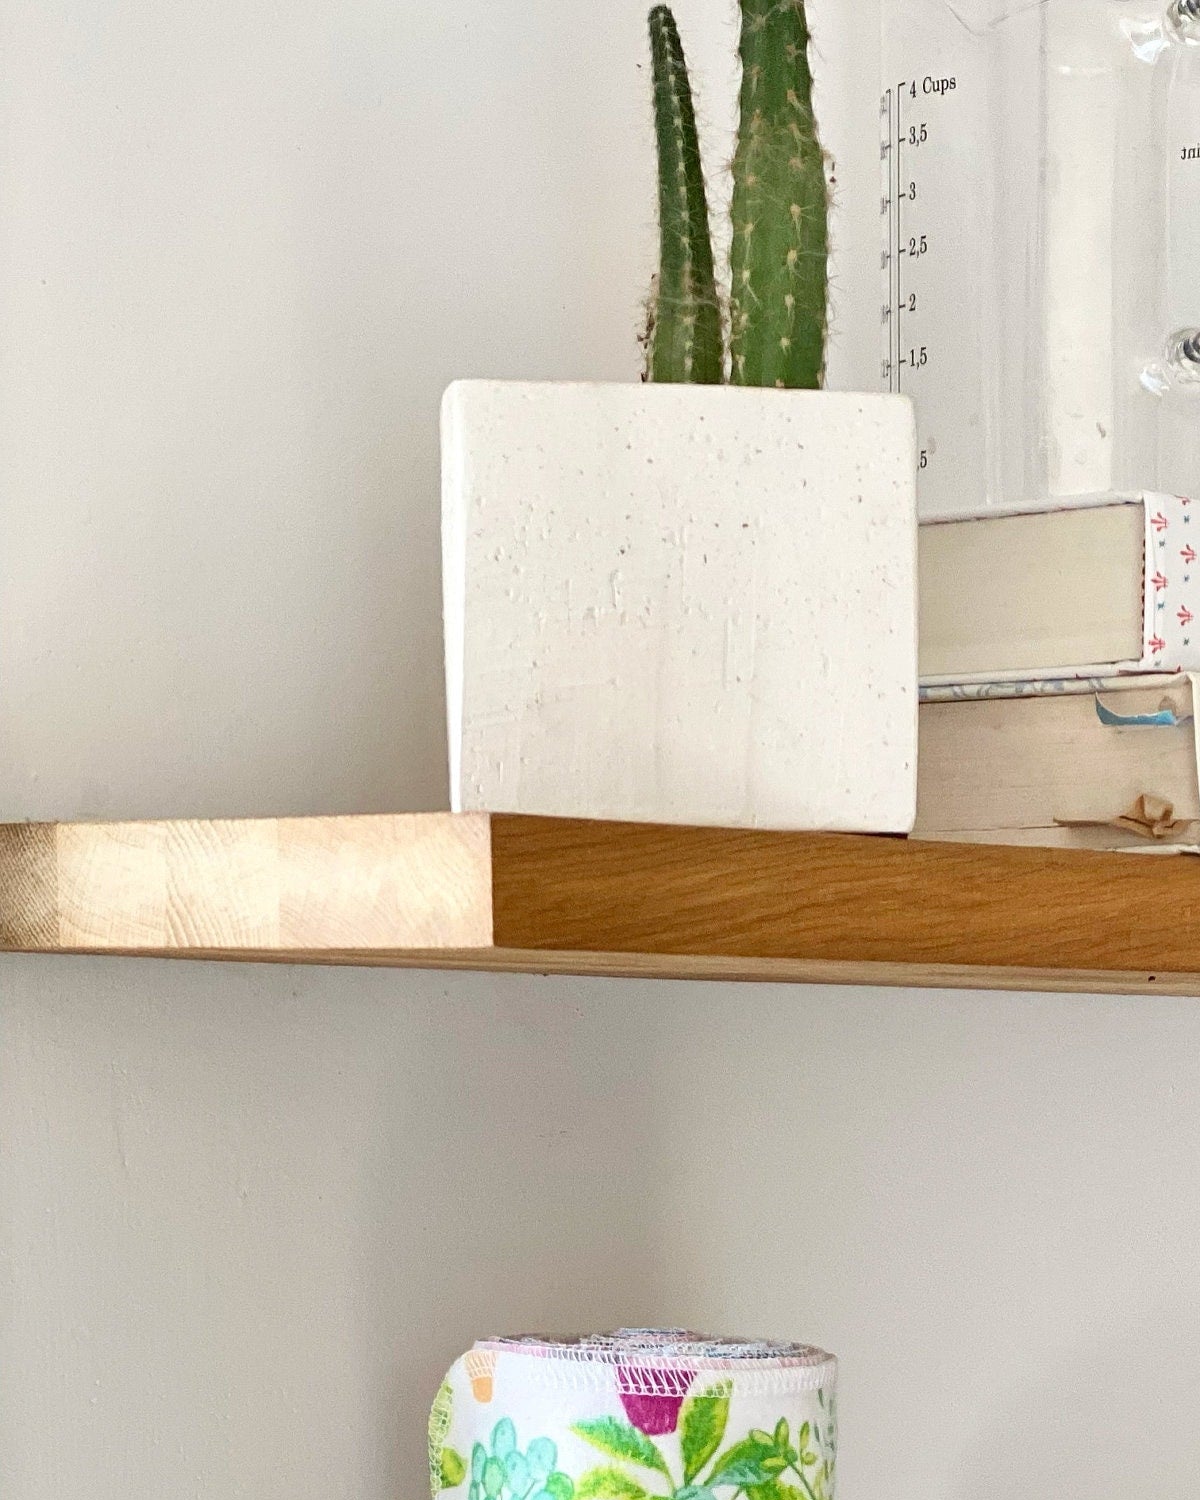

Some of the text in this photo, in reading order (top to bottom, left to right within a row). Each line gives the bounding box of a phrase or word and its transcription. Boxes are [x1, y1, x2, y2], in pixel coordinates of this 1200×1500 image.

[909, 76, 957, 98] 4 Cups
[909, 122, 928, 147] 3,5
[909, 181, 916, 200] 3
[909, 235, 928, 259] 2,5
[908, 293, 916, 312] 2
[909, 347, 928, 371] 1,5
